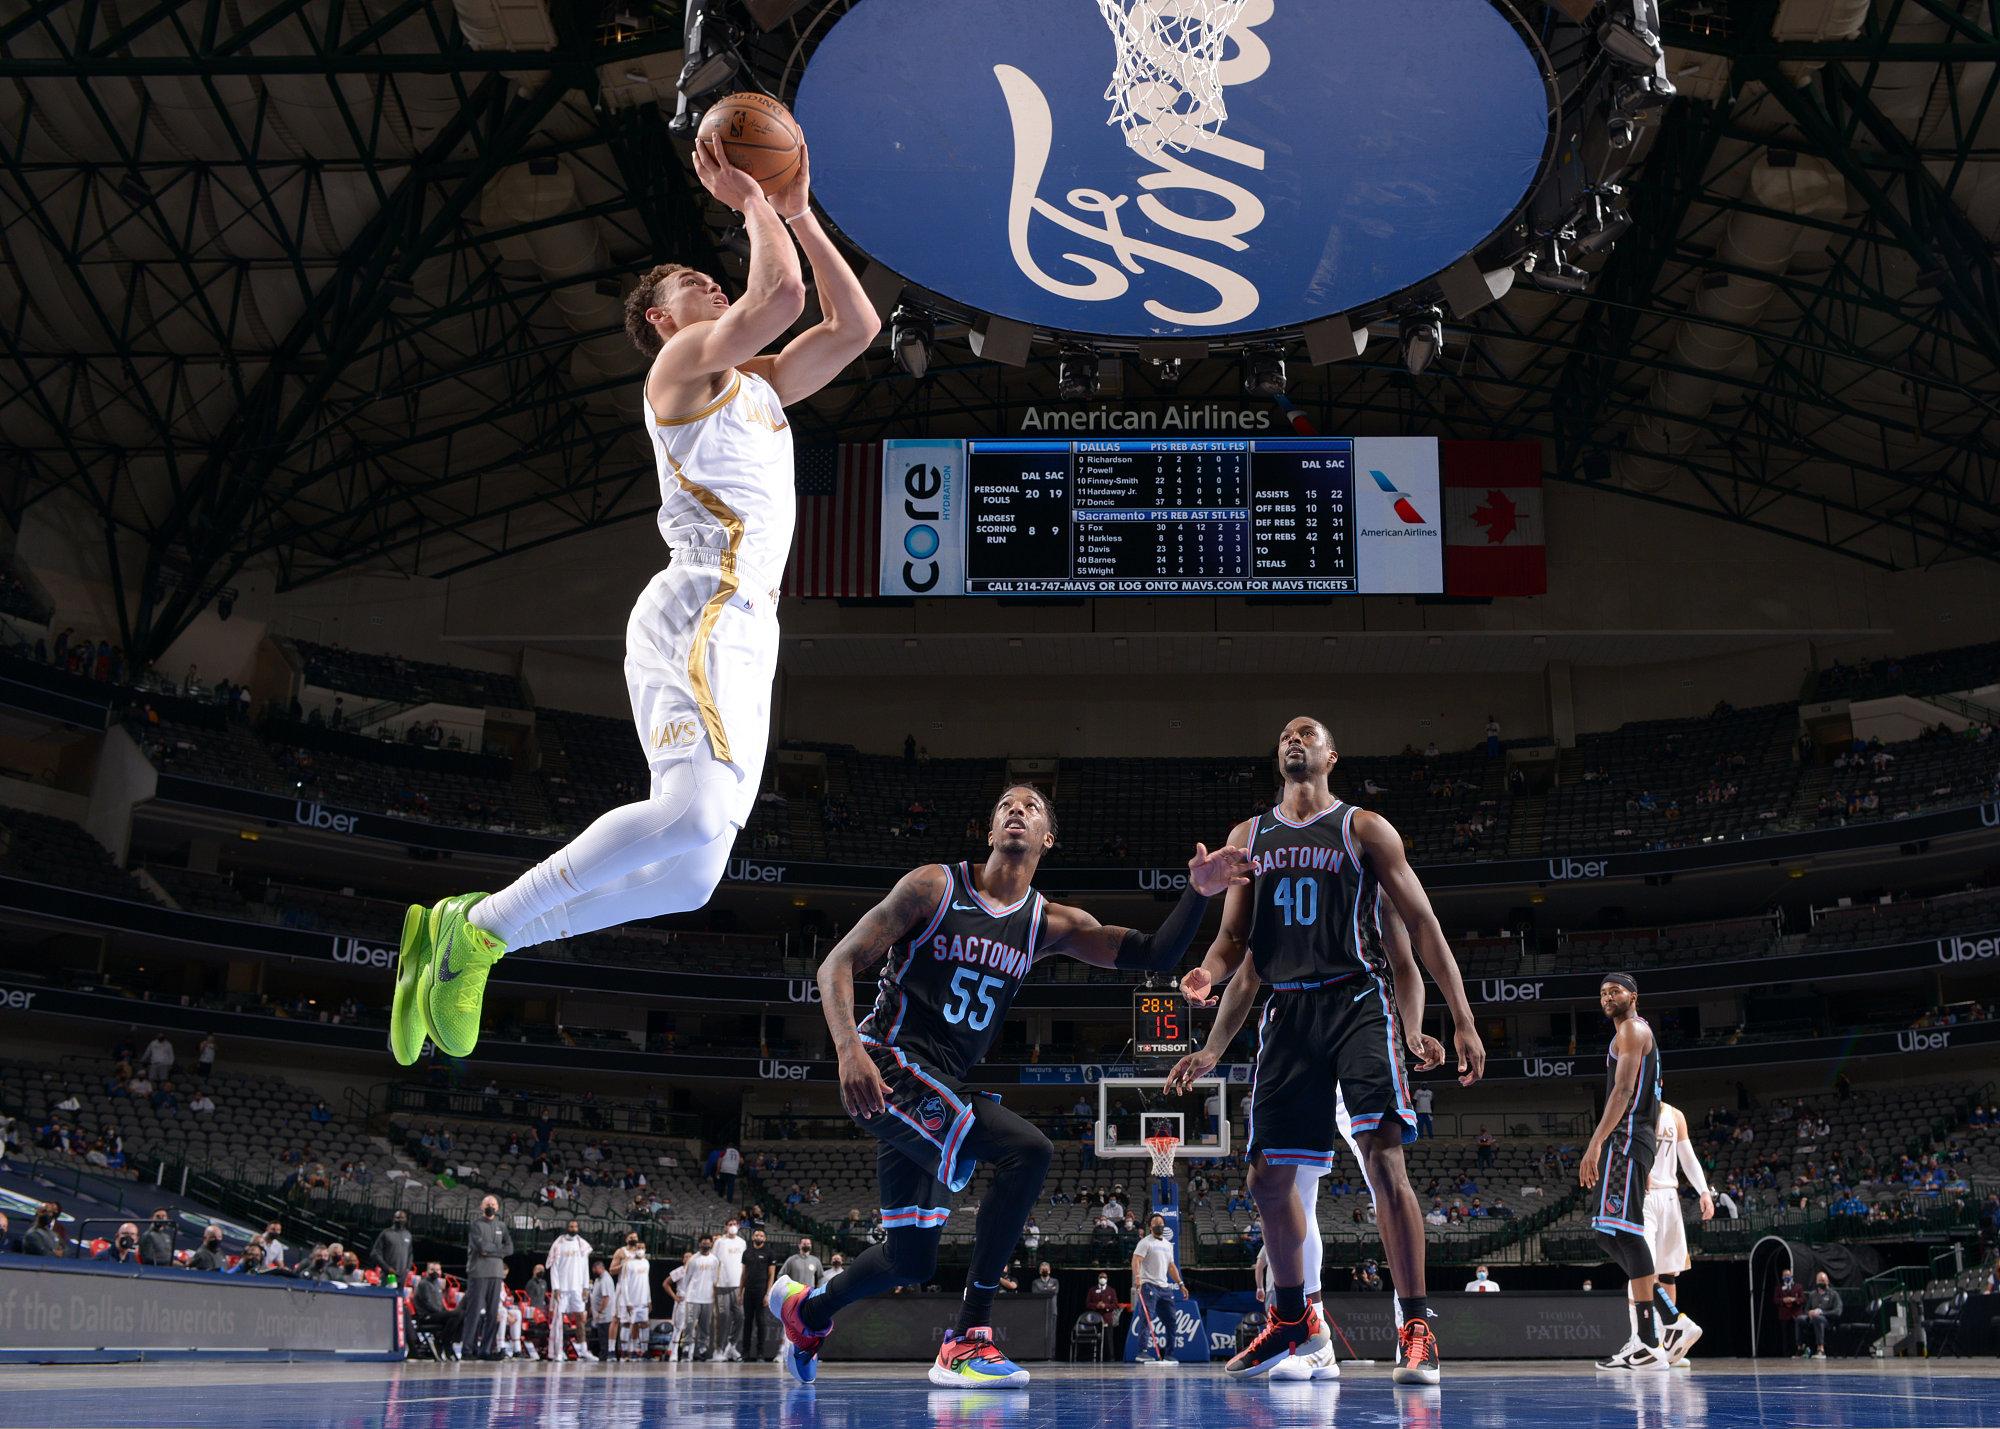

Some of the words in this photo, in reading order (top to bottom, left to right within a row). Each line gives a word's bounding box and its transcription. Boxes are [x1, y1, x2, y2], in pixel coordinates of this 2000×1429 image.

[1021, 405, 1165, 432] American
[1168, 405, 1271, 431] Airlines
[1081, 443, 1120, 451] DALLAS
[1326, 460, 1344, 468] SAC
[943, 465, 952, 520] HYDRATION
[1026, 490, 1039, 498] 20
[1050, 490, 1062, 498] 19
[1088, 488, 1126, 496] Hardaway
[1306, 490, 1316, 498] 15
[1331, 490, 1342, 498] 22
[1078, 512, 1145, 520] Sacramento
[1306, 504, 1317, 512] 10
[1332, 504, 1342, 512] 10
[902, 464, 942, 592] core
[1029, 527, 1035, 535] 8
[1052, 527, 1059, 535] 9
[1333, 518, 1342, 526] 31
[1017, 582, 1095, 590] 214-747-MAVS
[1099, 582, 1115, 590] OR
[1119, 582, 1141, 590] LOG
[1145, 582, 1178, 590] ONTO
[1182, 582, 1242, 590] MAVS.COM
[1247, 582, 1268, 590] FOR
[1308, 581, 1347, 589] TICKETS
[296, 802, 359, 834] Uber
[728, 860, 786, 882] Uber
[1252, 847, 1344, 876] SACTOWN
[1549, 858, 1608, 880] Uber
[1138, 870, 1190, 891] Ube
[1274, 877, 1318, 926] 40
[332, 937, 399, 970] Uber
[934, 935, 1027, 979] SACTOWN
[943, 967, 1004, 1031] 55
[1481, 979, 1543, 1002] Uber
[1142, 998, 1173, 1012] 28.4
[1156, 1014, 1179, 1039] 15
[1151, 1044, 1187, 1052] TISSOT
[1898, 1030, 1951, 1054] Uber
[759, 1061, 810, 1080] Uber
[1524, 1059, 1575, 1078] Uber
[70, 1295, 134, 1332] Dallas
[140, 1300, 235, 1335] Mavericks
[1539, 1312, 1583, 1322] TEQUILA
[1526, 1322, 1600, 1340] PATRÓN
